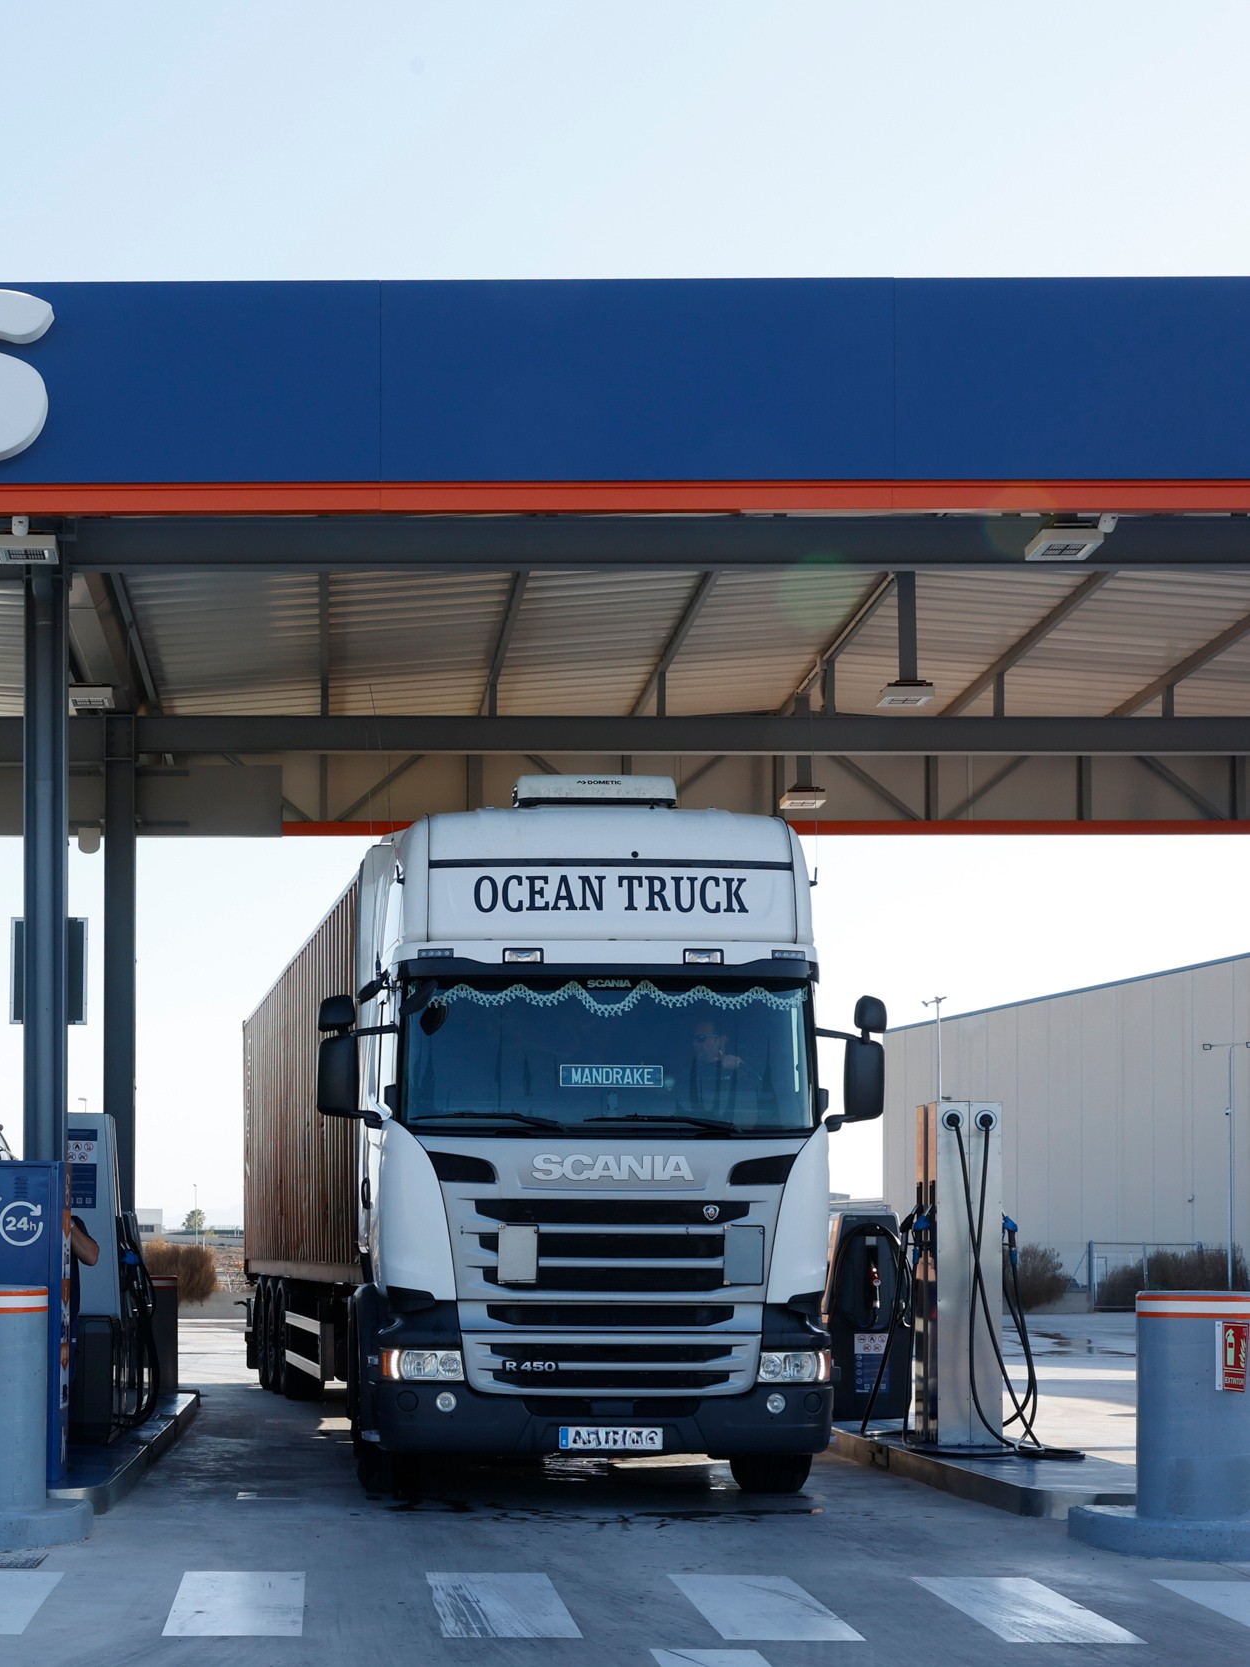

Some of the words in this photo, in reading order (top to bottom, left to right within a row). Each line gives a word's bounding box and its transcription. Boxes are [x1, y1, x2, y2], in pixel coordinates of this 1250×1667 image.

[473, 875, 606, 912] OCEAN
[617, 875, 749, 913] TRUCK
[587, 979, 632, 988] SCANIA
[571, 1067, 654, 1085] MANDRAKE
[531, 1153, 695, 1181] SCANIA
[5, 1216, 37, 1232] 24h
[505, 1361, 518, 1372] R
[520, 1361, 557, 1372] 450
